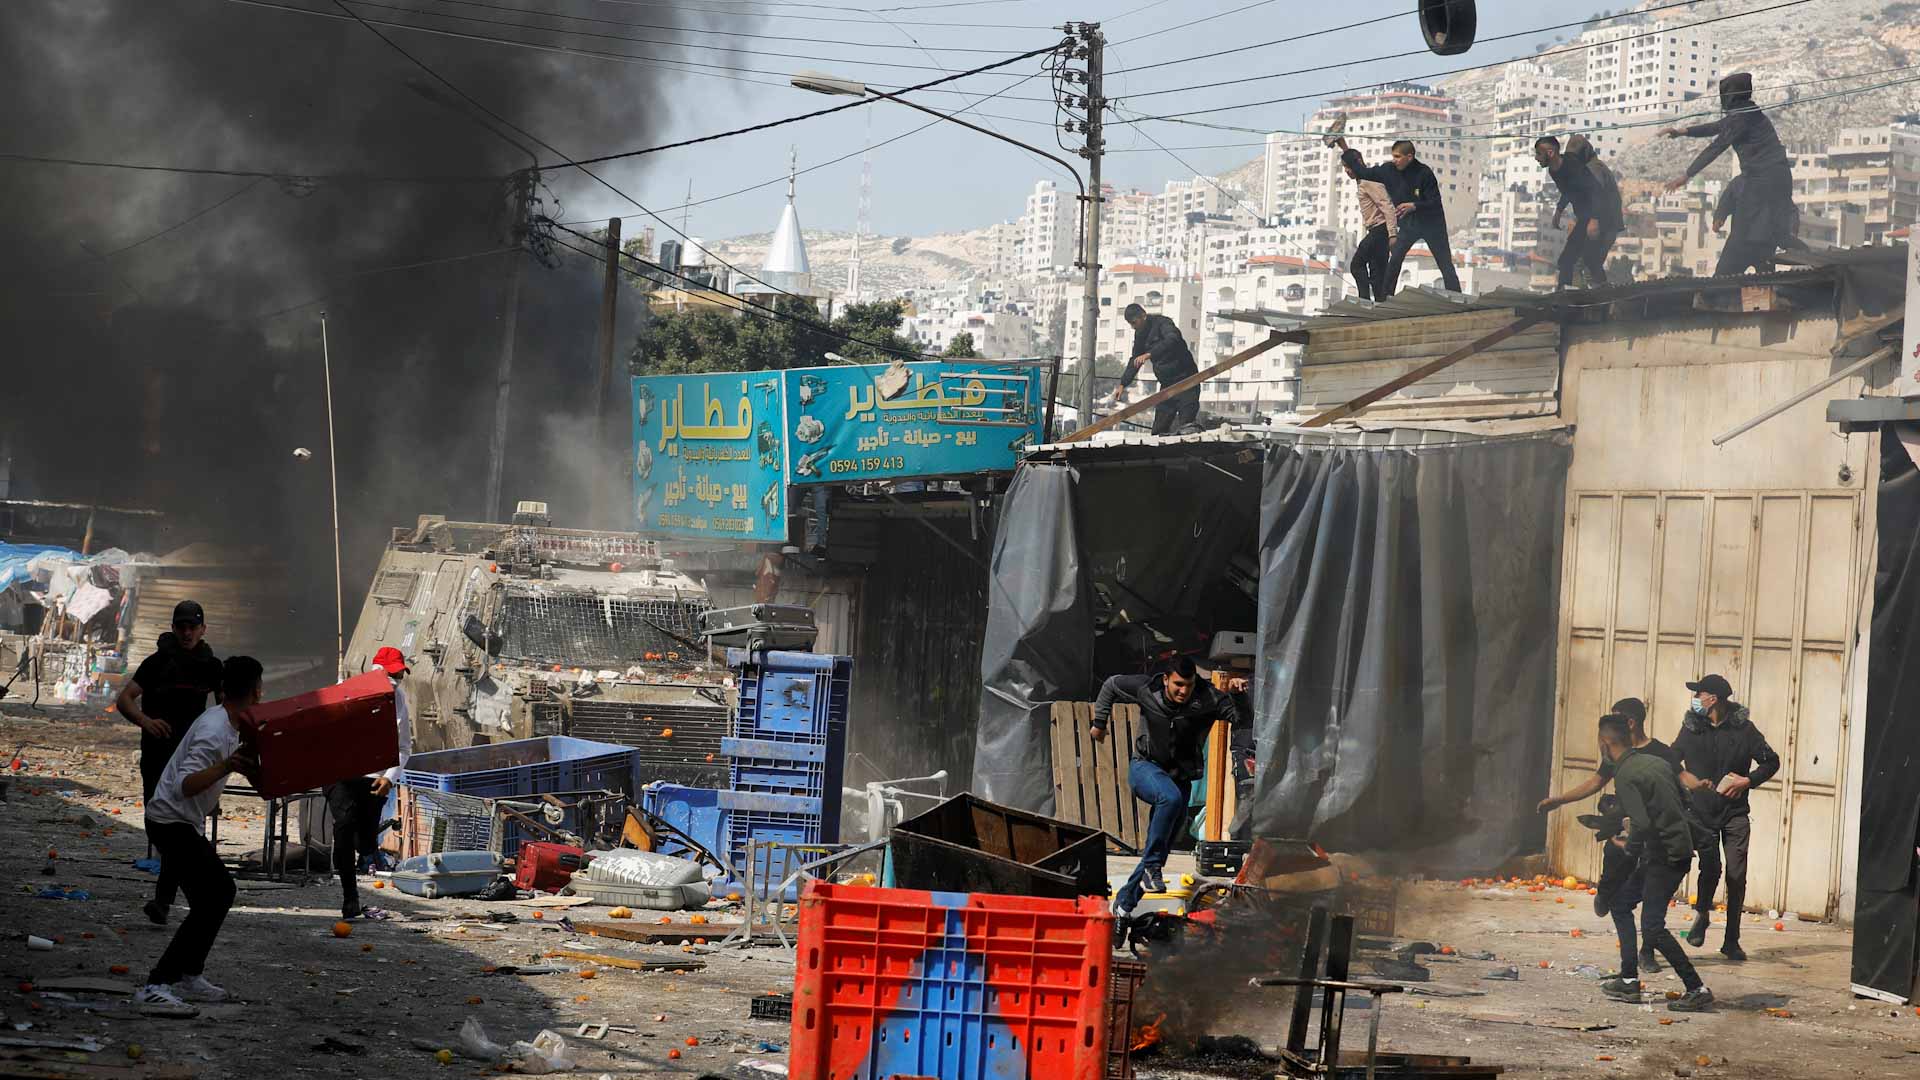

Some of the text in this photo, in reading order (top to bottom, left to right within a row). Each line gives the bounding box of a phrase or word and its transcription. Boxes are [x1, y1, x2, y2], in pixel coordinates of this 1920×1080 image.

[658, 380, 753, 457] فطاير
[883, 410, 917, 425] واليدوية
[857, 426, 890, 453] تأجير
[903, 428, 941, 448] صيانة
[956, 431, 977, 446] بيع
[830, 455, 904, 473] 0594 159 413
[663, 464, 687, 507] تأجير
[696, 472, 722, 508] صيانة
[732, 482, 748, 509] بيع
